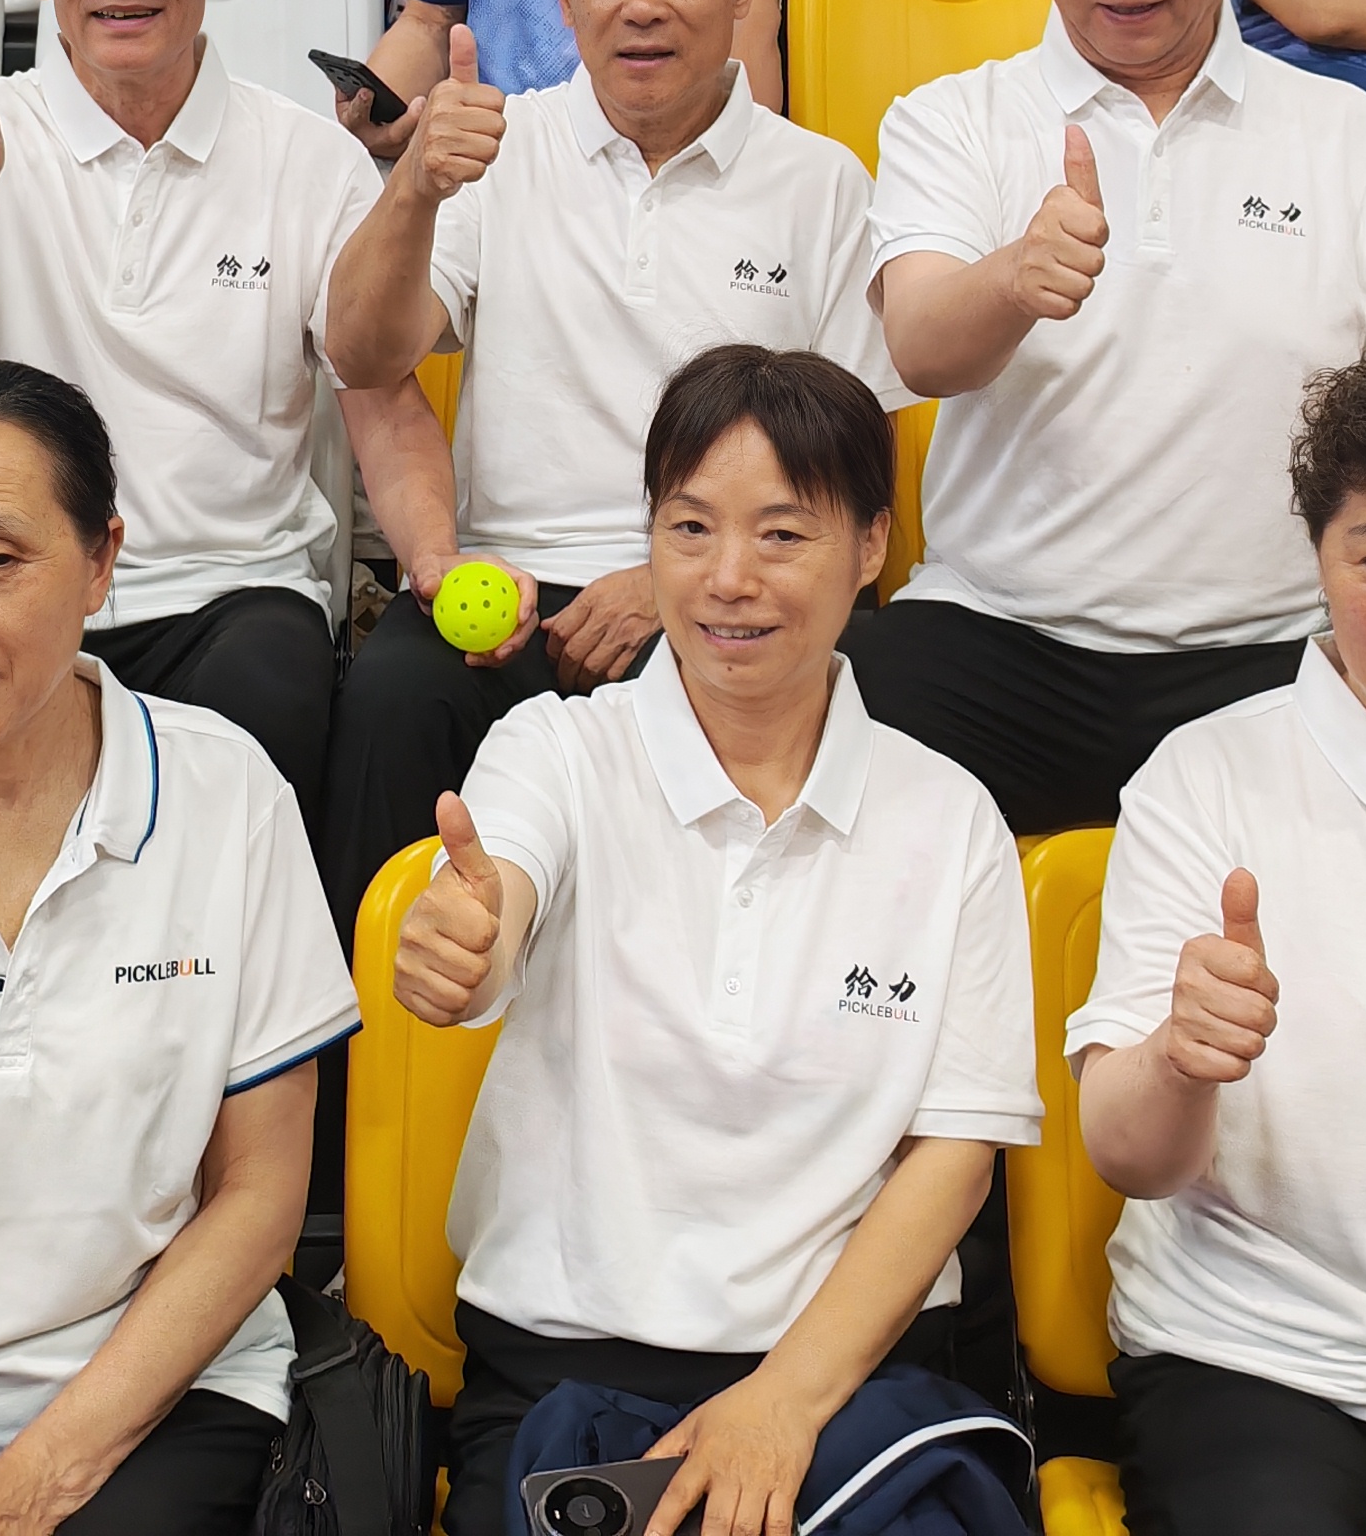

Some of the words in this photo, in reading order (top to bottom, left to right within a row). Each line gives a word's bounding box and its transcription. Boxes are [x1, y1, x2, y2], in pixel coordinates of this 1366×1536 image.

[1242, 195, 1302, 222] 给力
[1238, 218, 1306, 237] PICKLEBULL
[217, 254, 271, 279] 给力
[734, 259, 787, 284] 给力
[212, 277, 270, 290] PICKLEBUL
[729, 281, 790, 298] PICKLEBULL
[115, 958, 216, 984] PICKLEBULL
[844, 964, 916, 1003] 给力
[838, 999, 920, 1023] PICKLEBULL
